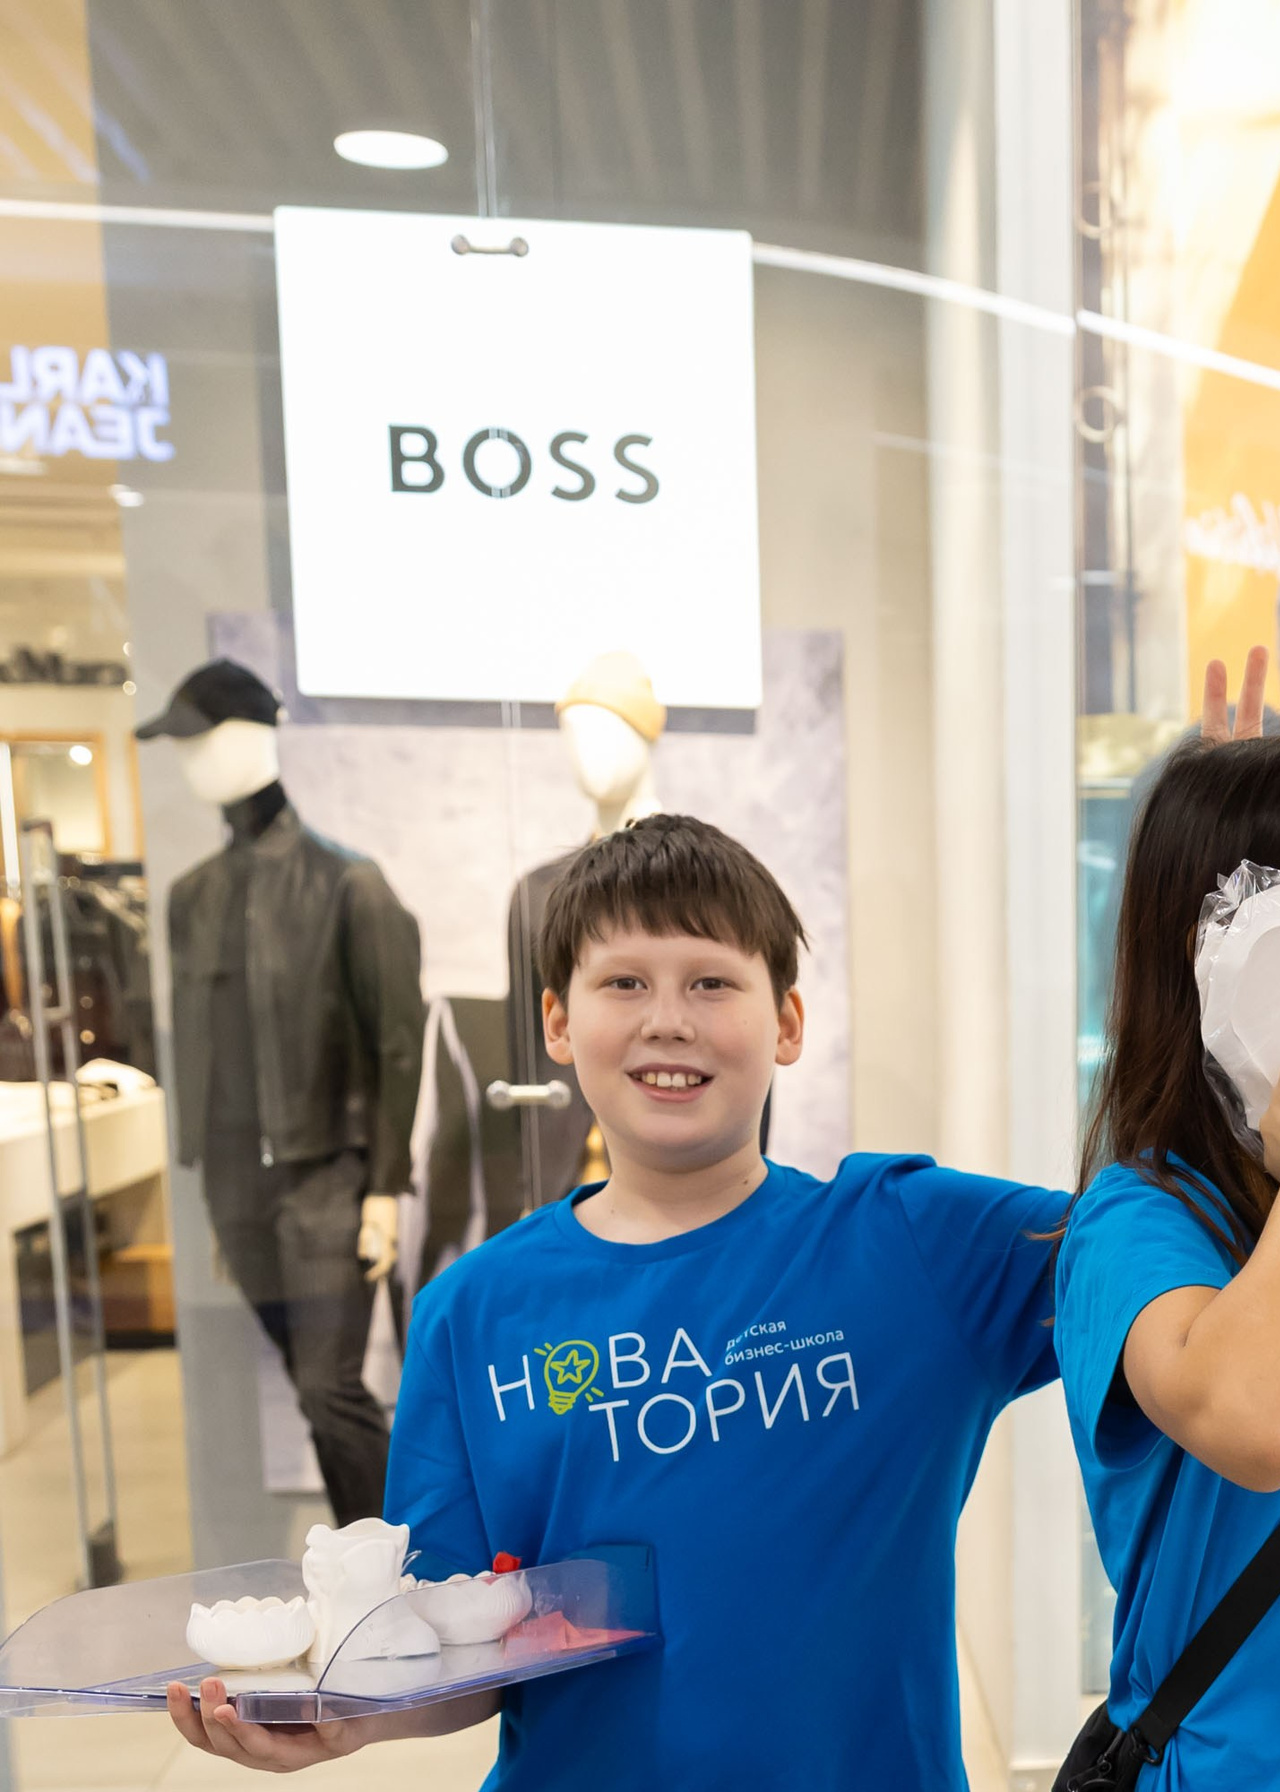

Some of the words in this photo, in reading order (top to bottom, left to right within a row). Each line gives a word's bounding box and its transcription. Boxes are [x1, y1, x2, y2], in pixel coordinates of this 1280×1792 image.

[387, 424, 661, 505] BOSS
[724, 1329, 845, 1366] бизнес-школа
[588, 1351, 860, 1462] ТОРИЯ
